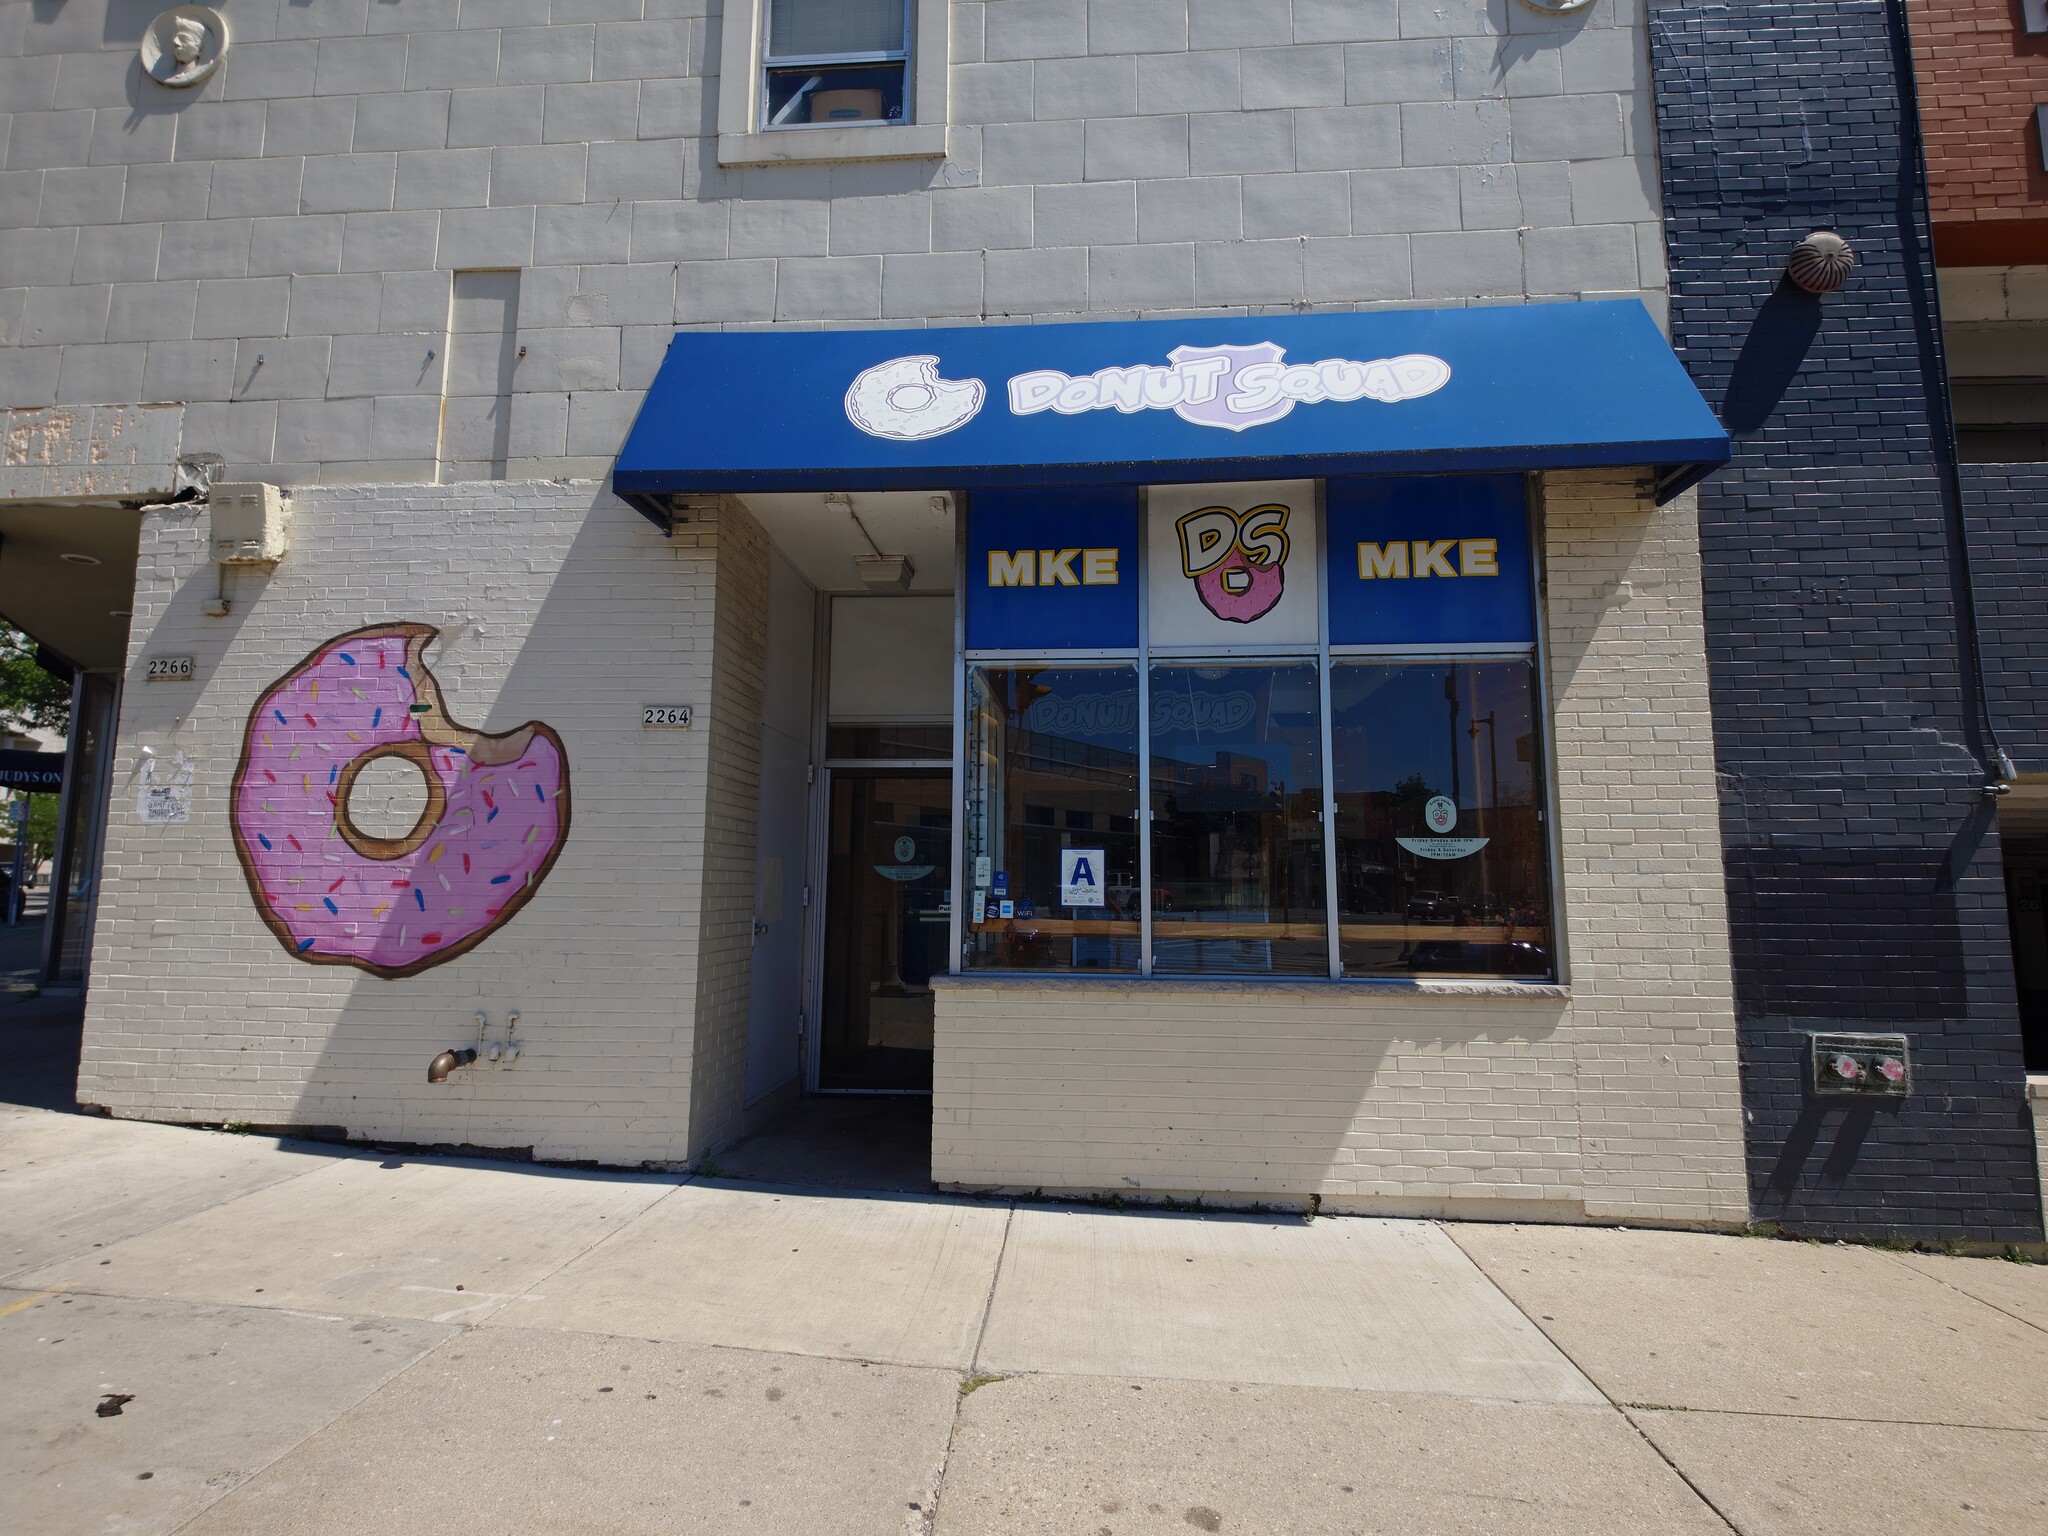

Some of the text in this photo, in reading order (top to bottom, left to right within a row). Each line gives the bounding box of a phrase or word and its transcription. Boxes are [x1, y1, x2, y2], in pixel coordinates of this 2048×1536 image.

[1226, 353, 1451, 413] SQUAD
[1176, 505, 1290, 580] DS
[1358, 538, 1497, 580] MKE
[988, 548, 1119, 588] MKE
[149, 660, 189, 675] 2266
[645, 709, 689, 724] 2264
[1070, 857, 1096, 886] A
